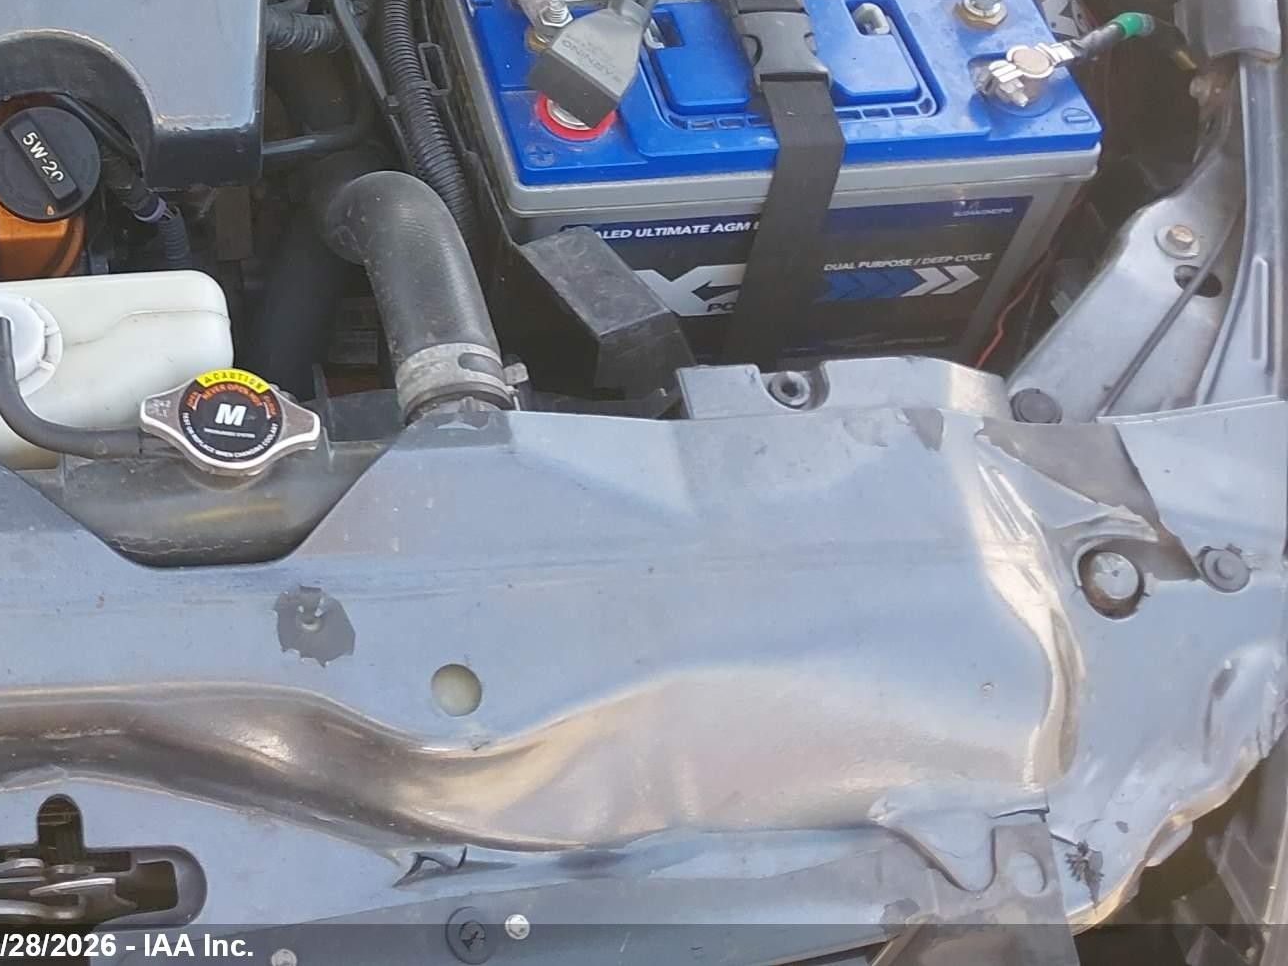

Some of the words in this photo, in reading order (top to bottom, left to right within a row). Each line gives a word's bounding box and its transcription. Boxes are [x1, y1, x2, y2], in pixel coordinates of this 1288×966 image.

[634, 224, 711, 239] ULTIMATE
[711, 222, 752, 234] AGM
[823, 261, 857, 271] DUAL
[858, 258, 913, 269] PURPOSE
[922, 255, 954, 265] DEEP
[954, 252, 994, 263] CYCLE
[213, 372, 267, 390] CAUTION
[214, 403, 247, 427] M
